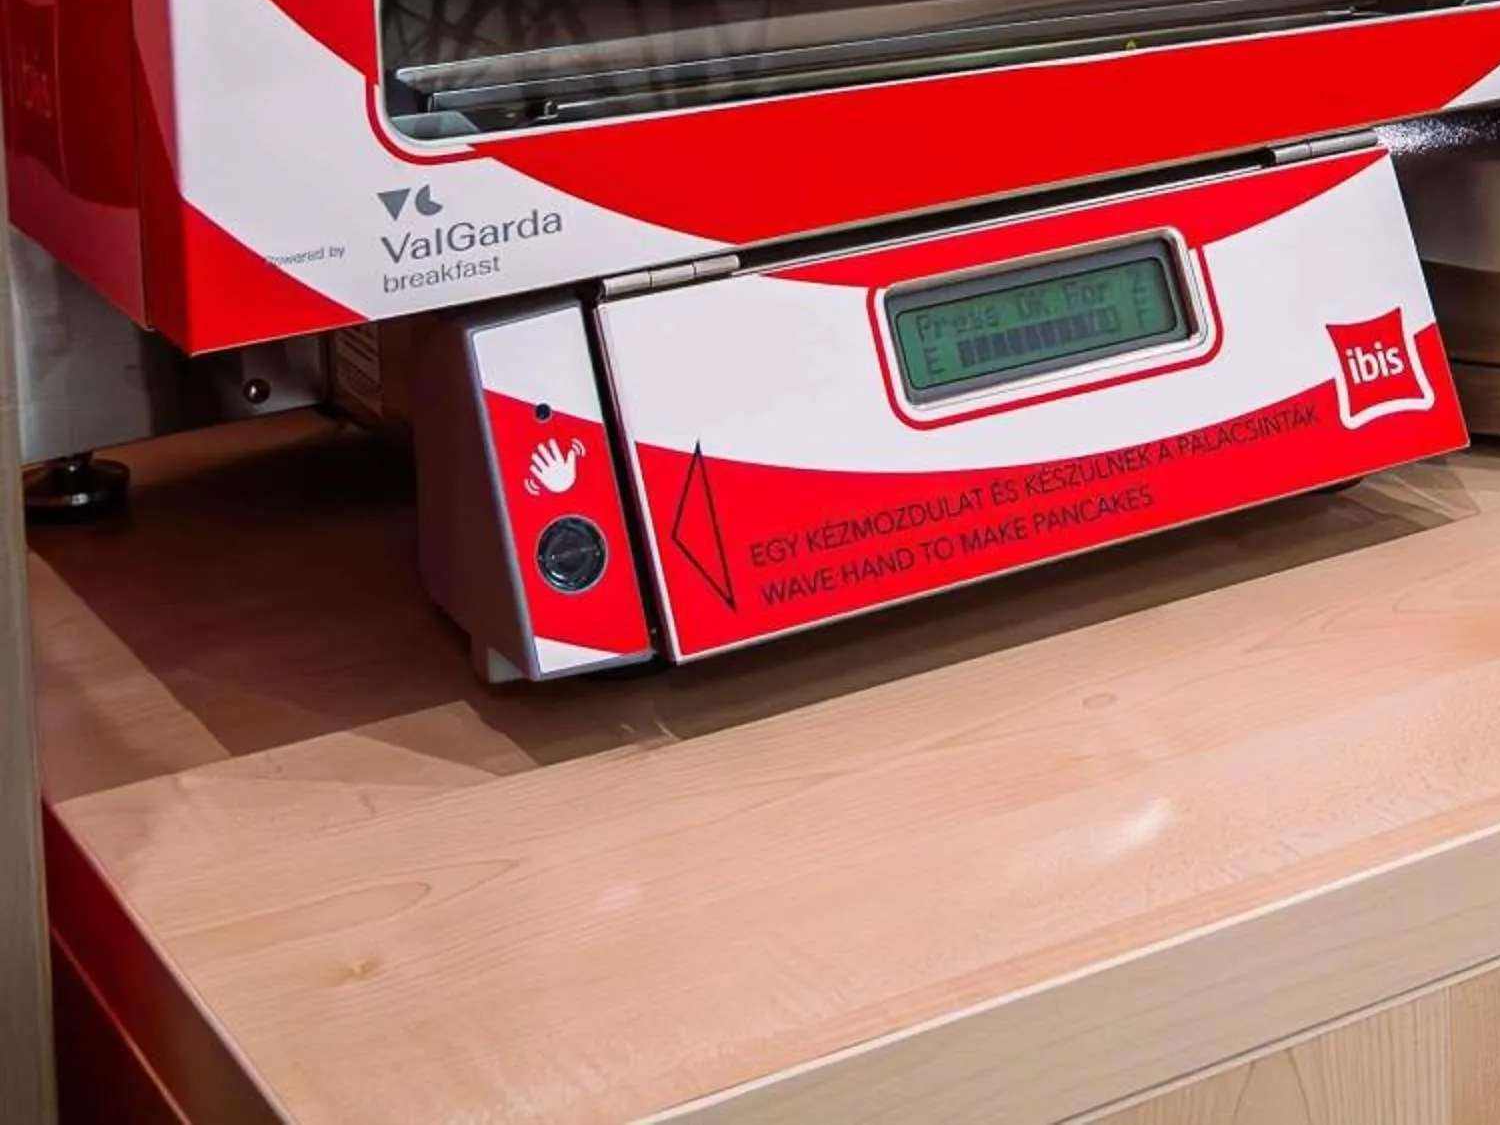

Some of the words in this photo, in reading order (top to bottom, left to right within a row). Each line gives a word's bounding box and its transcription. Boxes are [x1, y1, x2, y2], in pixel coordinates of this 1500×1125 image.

[328, 245, 346, 259] by
[381, 208, 562, 264] ValGarda
[382, 255, 501, 294] breakfast
[1345, 340, 1404, 384] ibis
[751, 535, 799, 568] EGY
[805, 487, 984, 555] KÉZMOZDULAT
[990, 479, 1019, 507] ÉS
[1157, 442, 1174, 464] A
[759, 567, 836, 607] WAVE
[841, 547, 916, 588] HAND
[919, 537, 955, 563] TO
[960, 516, 1029, 554] MAKE
[1032, 484, 1155, 534] PANCAKES
